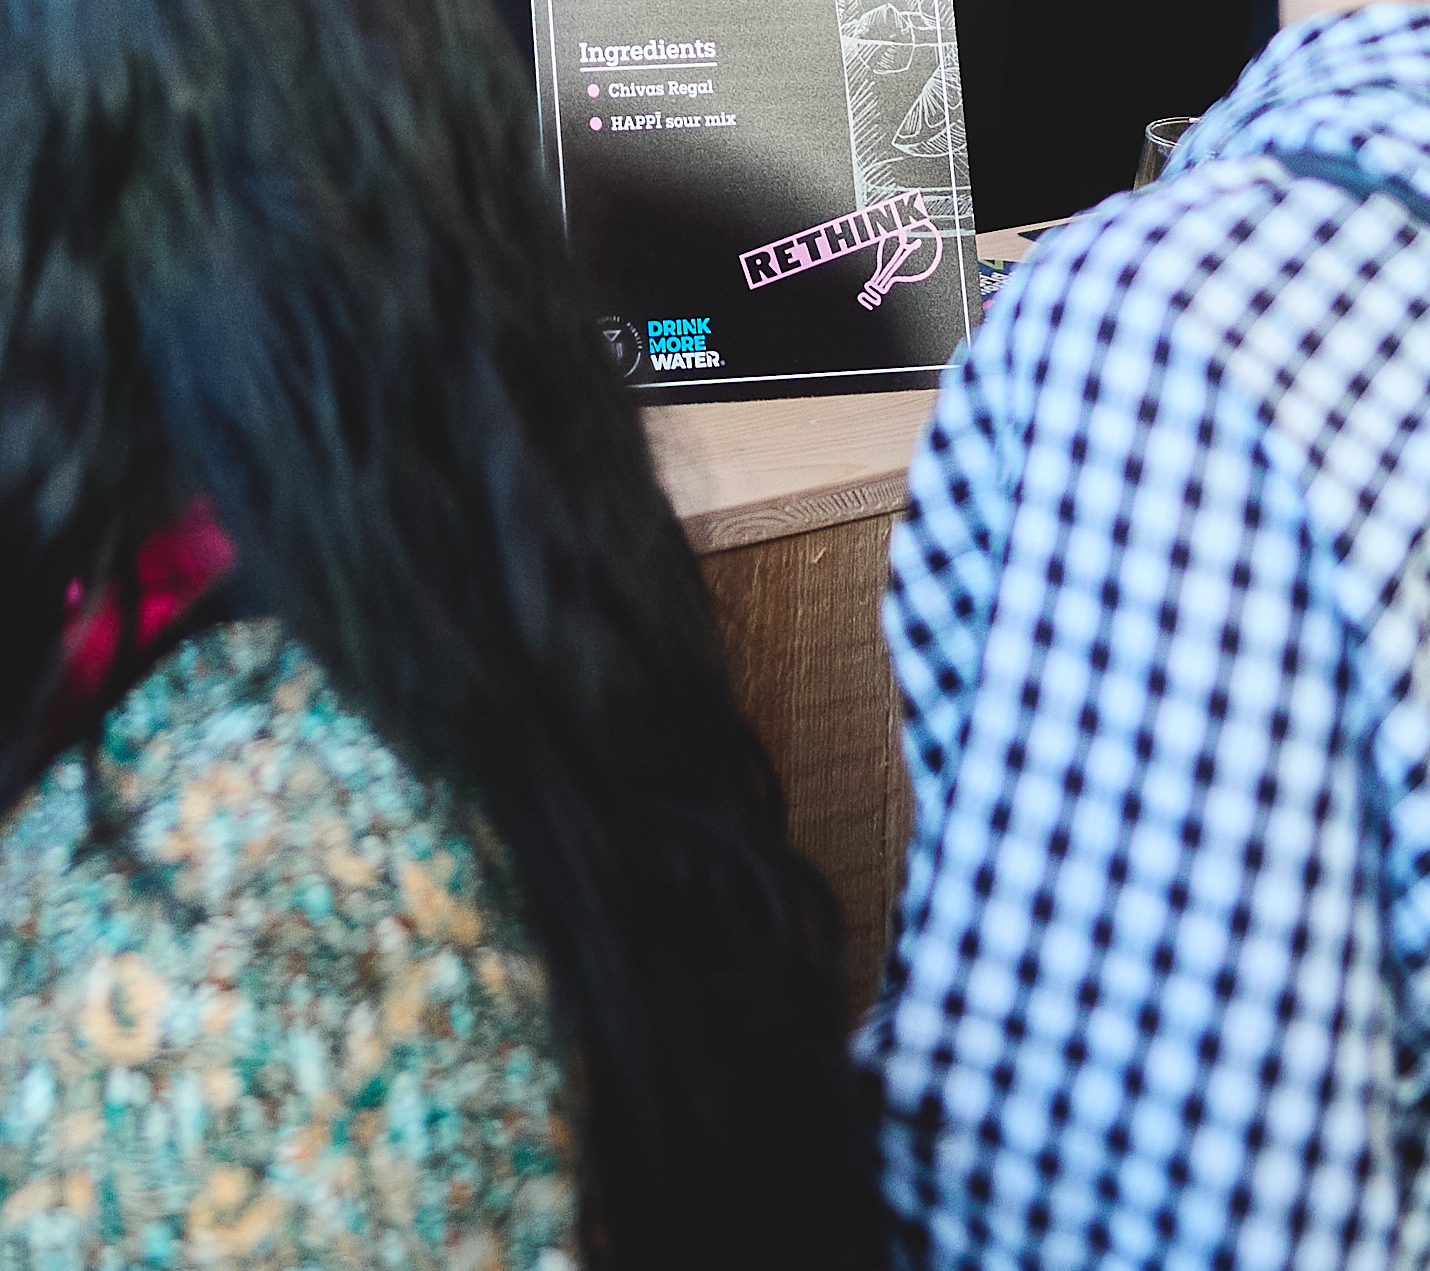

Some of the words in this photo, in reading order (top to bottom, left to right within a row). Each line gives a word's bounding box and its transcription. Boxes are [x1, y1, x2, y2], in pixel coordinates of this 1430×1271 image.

[578, 39, 717, 67] Ingredients
[608, 82, 665, 98] Chivas
[667, 79, 714, 98] Regal
[665, 115, 703, 129] sour
[704, 111, 738, 127] mix
[745, 193, 931, 285] RETHINK
[647, 317, 712, 337] DRINK
[649, 335, 707, 354] MORE
